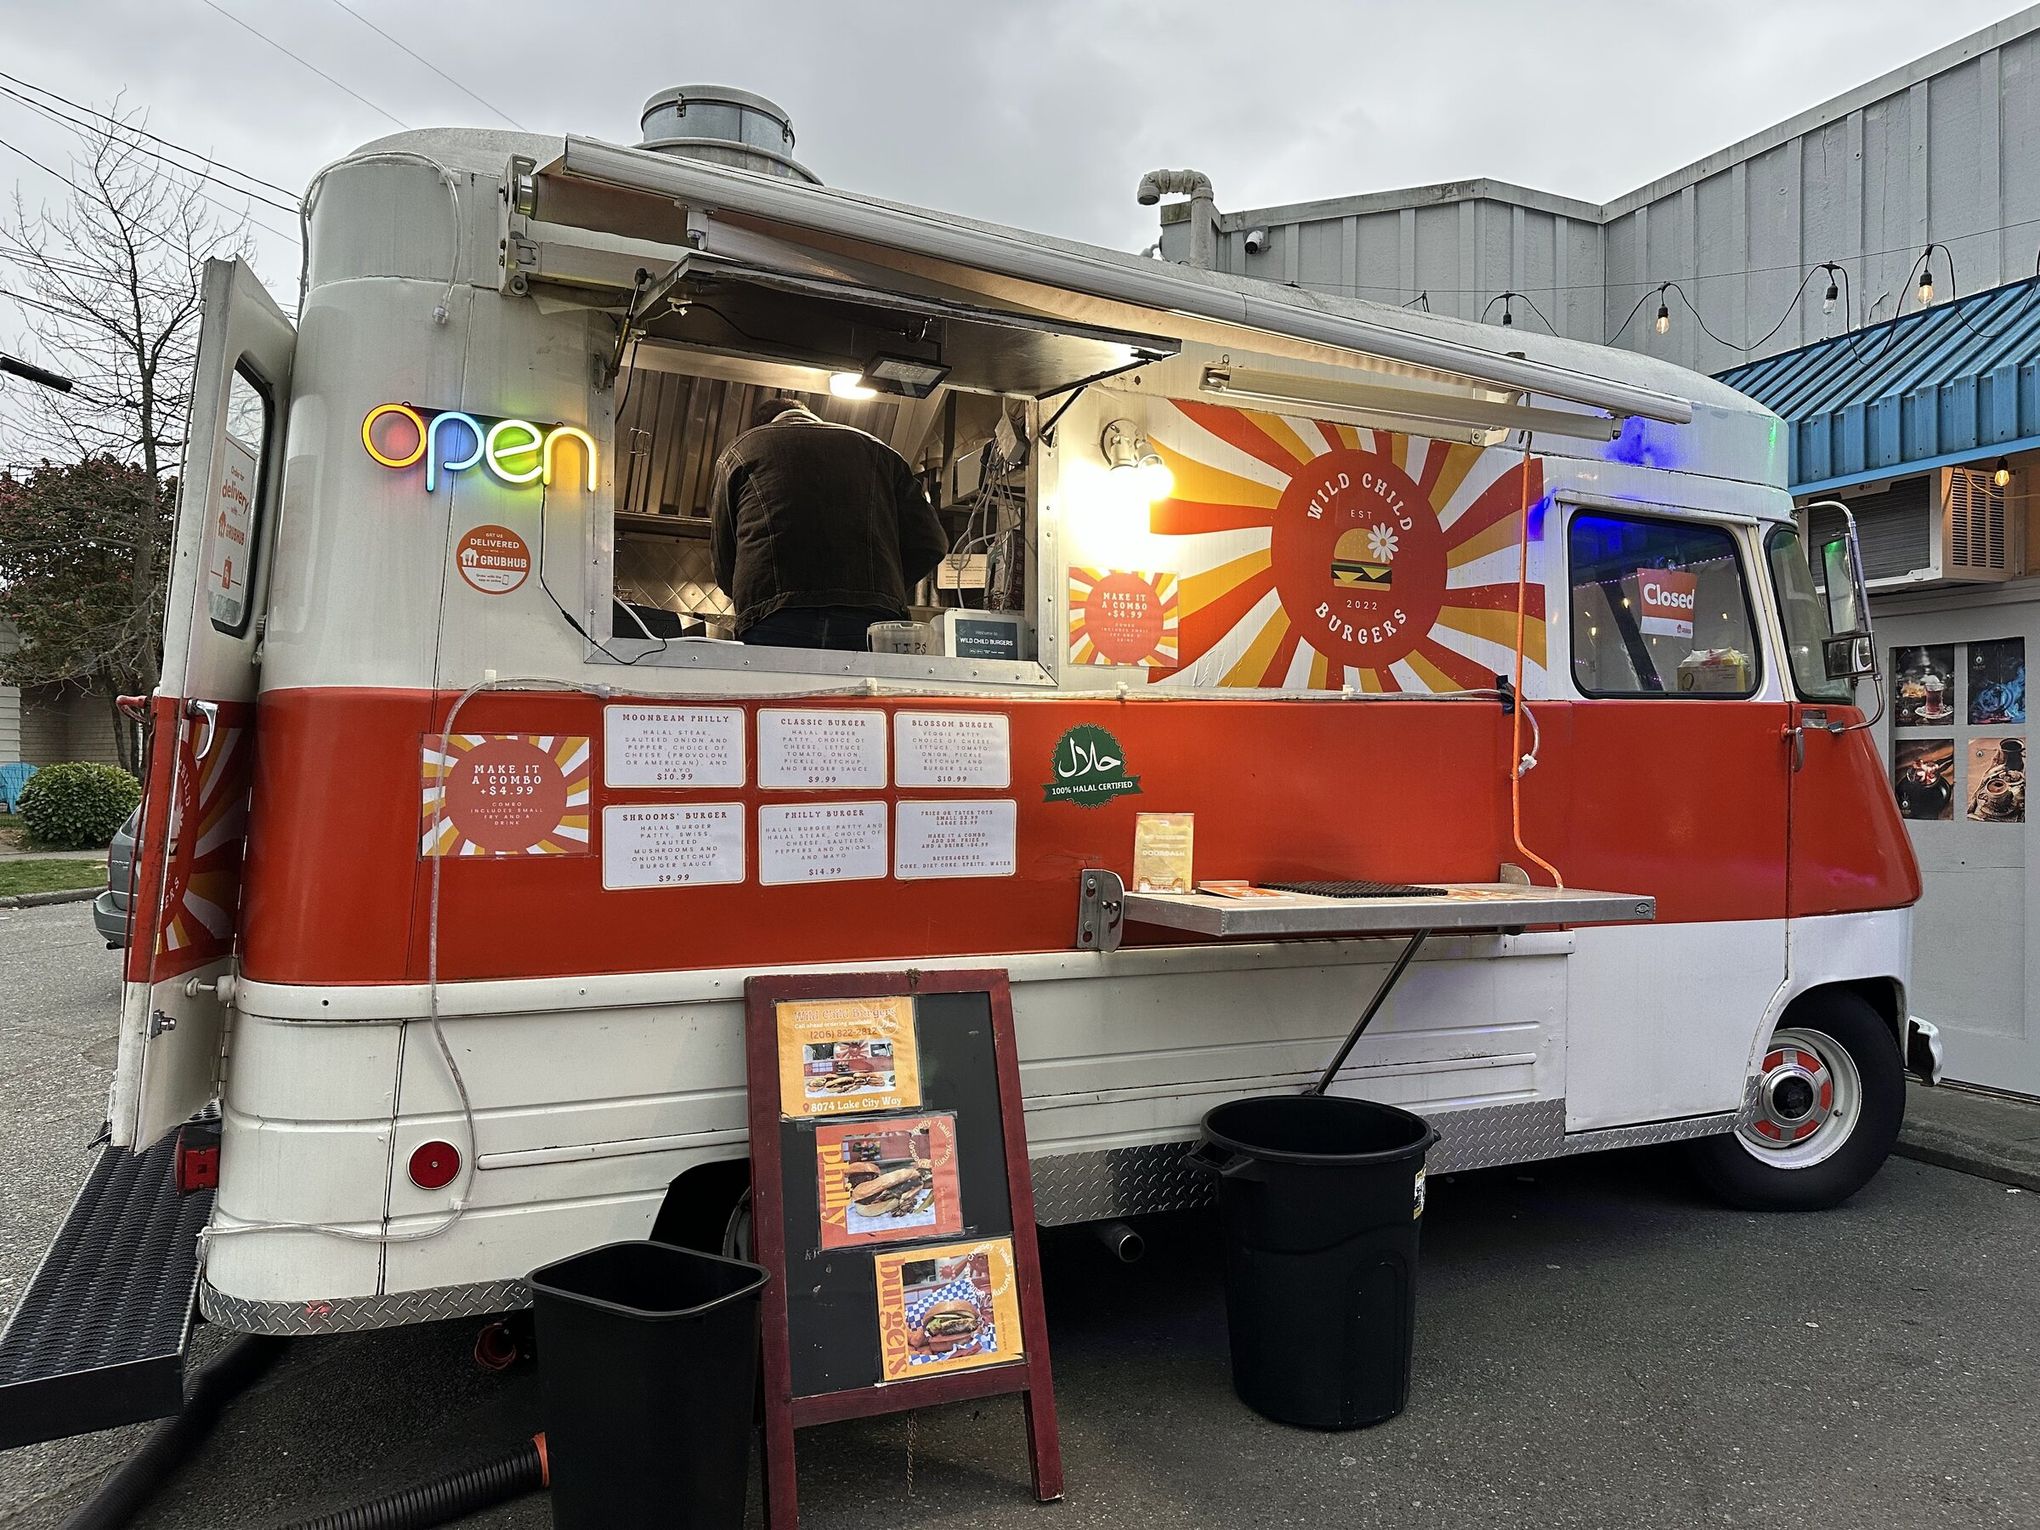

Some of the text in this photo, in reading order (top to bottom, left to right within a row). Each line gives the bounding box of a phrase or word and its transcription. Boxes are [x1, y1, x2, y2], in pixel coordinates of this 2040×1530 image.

[361, 403, 597, 493] open
[221, 479, 250, 515] delivery
[1307, 472, 1413, 531] WILD CHILD
[1350, 509, 1372, 519] EST
[470, 538, 520, 549] DELIVERED
[480, 555, 527, 568] GRUBHUB
[1103, 592, 1147, 602] MAKE IT
[1643, 583, 1695, 610] Closed
[1101, 601, 1148, 611] A COMBO
[1346, 599, 1378, 611] 2022
[1107, 610, 1143, 619] +$4.99
[1315, 602, 1407, 644] BURGERS
[892, 642, 927, 656] TIPS
[622, 714, 729, 723] MOONBEAM PHILLY
[780, 718, 823, 726] CLASSIC
[912, 720, 994, 729] BLOSSOM BURGER
[1058, 737, 1121, 778] حلال
[474, 764, 540, 774] MAKE IT
[471, 776, 543, 785] A COMBO
[656, 773, 694, 781] $10.99
[937, 775, 968, 783] $10.99
[480, 786, 535, 796] +$4.99
[1052, 781, 1133, 795] 100% HALAL CERTIFIED
[622, 811, 728, 822] SHROOMS' BURGER
[785, 809, 865, 819] PHILLY BURGER
[634, 846, 694, 854] MUSHROOMS
[774, 847, 812, 855] PEPPERS
[808, 867, 842, 876] $14.99
[658, 874, 690, 883] $9.99
[810, 1030, 835, 1040] (206)
[836, 1026, 877, 1038] 822-2812
[810, 1096, 902, 1113] 8074 Lake City Way
[912, 1119, 932, 1135] melty
[936, 1120, 953, 1138] halal
[934, 1144, 953, 1167] yummy
[817, 1144, 850, 1229] philly
[880, 1257, 907, 1376] burgers
